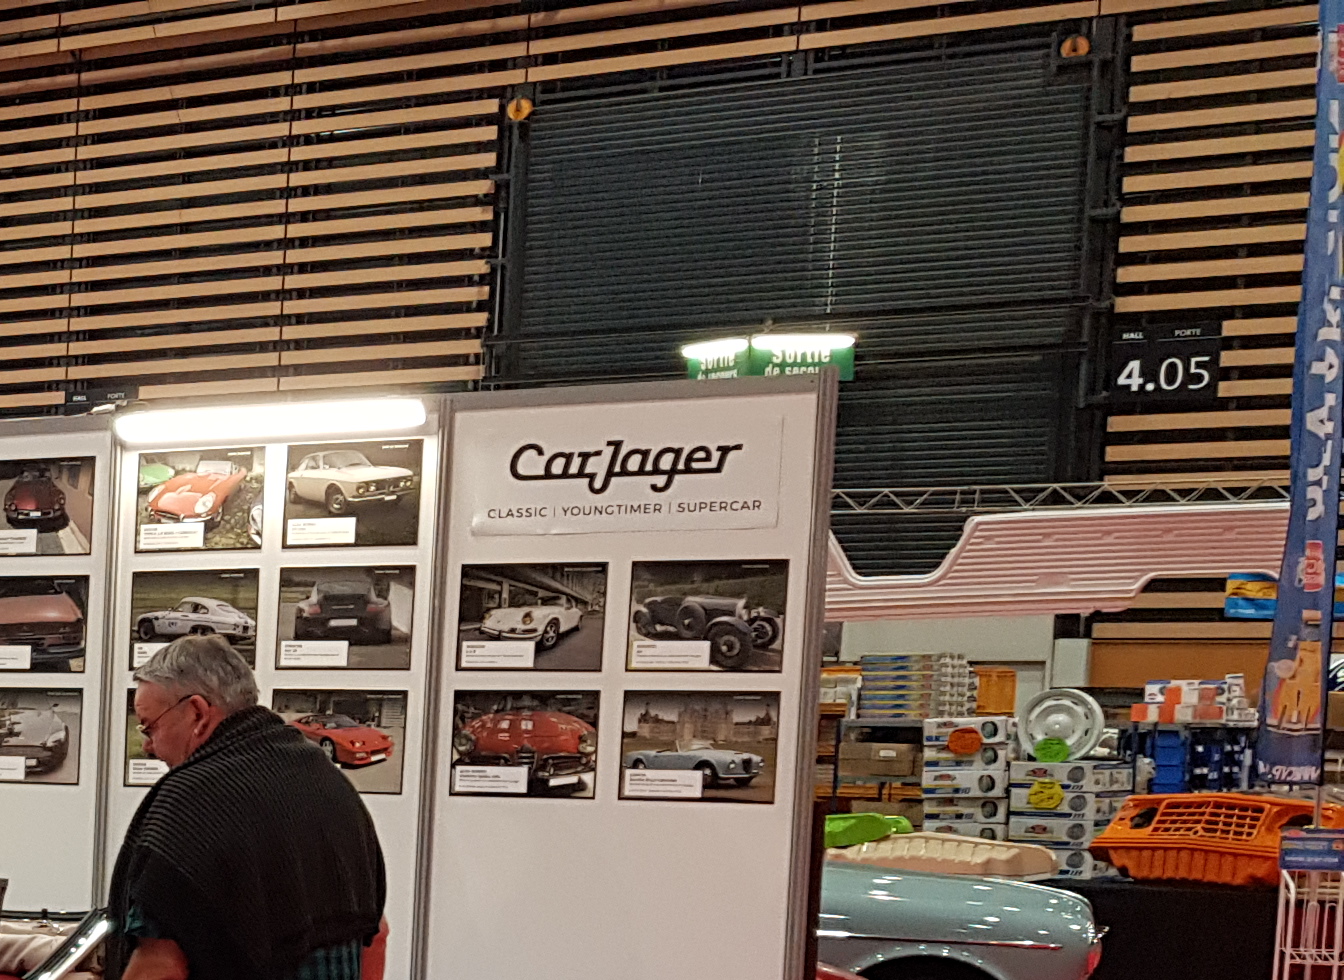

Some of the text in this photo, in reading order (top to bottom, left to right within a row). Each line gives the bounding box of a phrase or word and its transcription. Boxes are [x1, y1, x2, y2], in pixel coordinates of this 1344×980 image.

[1122, 328, 1201, 340] HALL PORTE
[1117, 356, 1212, 392] 4.05
[509, 439, 744, 495] CarJager
[487, 499, 762, 520] CLASSIC YOUNGTIMER SUPERCAR
